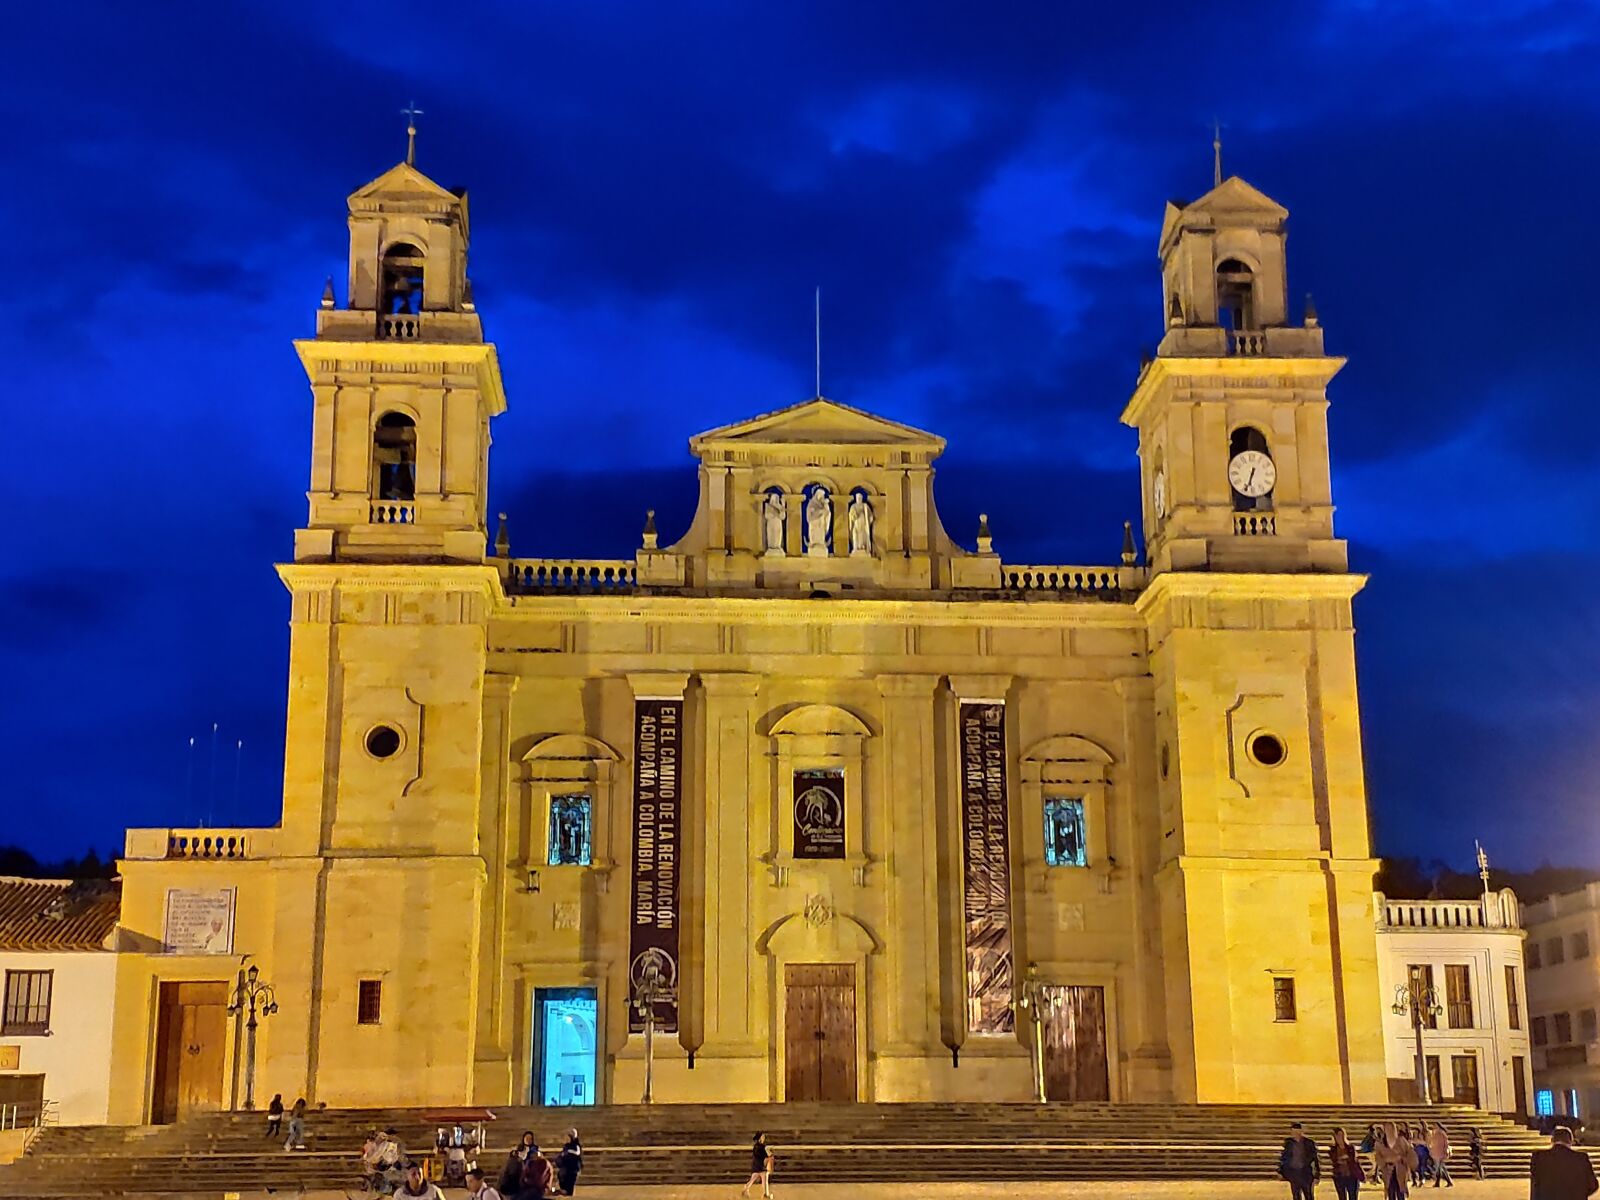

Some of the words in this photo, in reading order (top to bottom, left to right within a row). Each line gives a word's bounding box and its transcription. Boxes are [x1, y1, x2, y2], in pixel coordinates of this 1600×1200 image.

[661, 707, 676, 724] EN
[660, 728, 675, 744] EL
[985, 731, 1000, 746] EL
[640, 715, 658, 787] ACOMPAÑA
[966, 718, 985, 788] ACOMPAÑA
[660, 747, 676, 799] CAMINO
[986, 749, 1002, 800] CAMINO
[640, 791, 655, 799] A
[968, 793, 982, 801] A
[659, 803, 675, 819] DE
[987, 804, 1003, 820] DE
[659, 824, 674, 840] LA
[988, 825, 1003, 841] LA
[657, 844, 675, 929] RENOVACIÓN
[636, 880, 656, 925] MARÍA
